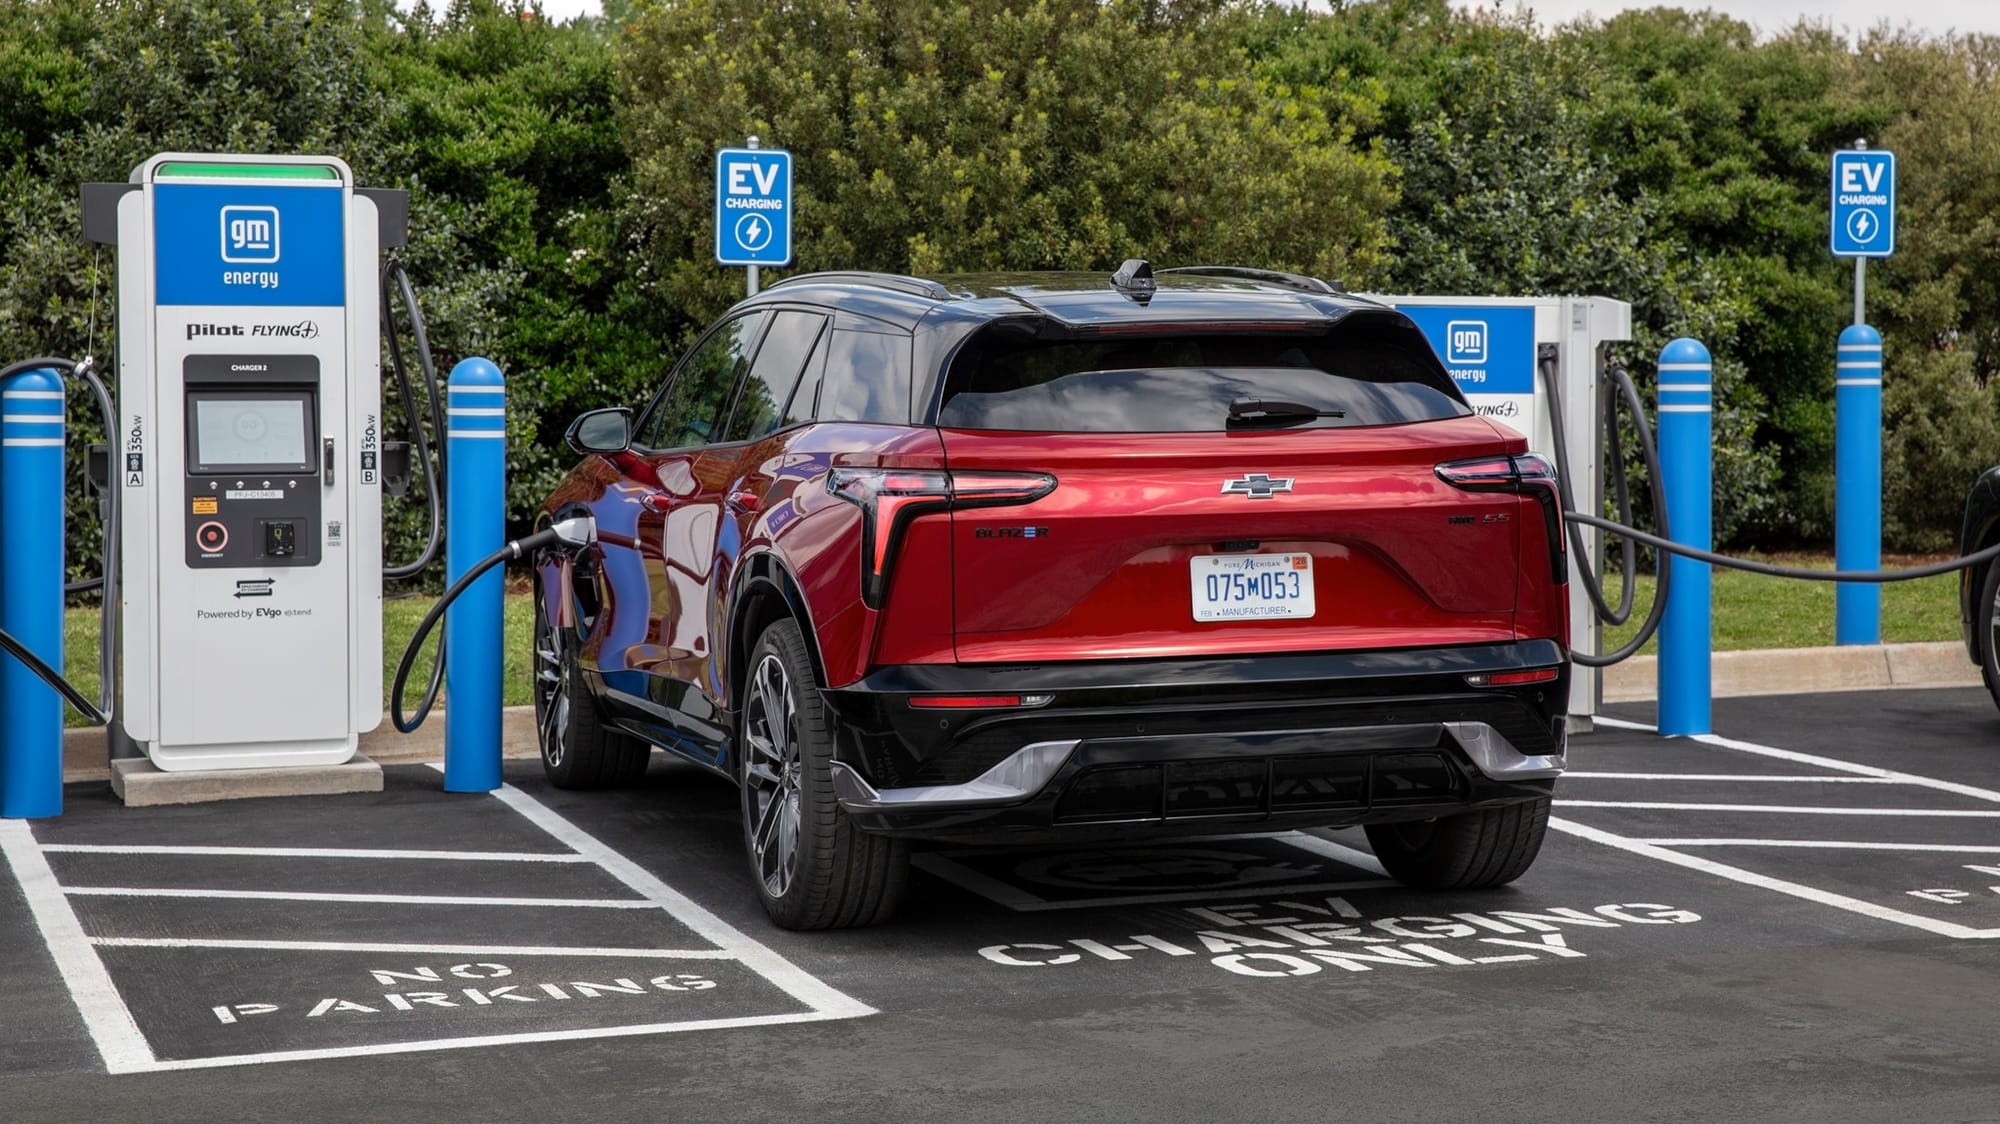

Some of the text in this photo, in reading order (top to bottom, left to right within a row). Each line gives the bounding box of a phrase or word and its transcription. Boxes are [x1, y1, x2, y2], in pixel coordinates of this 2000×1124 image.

[728, 162, 780, 195] EV
[1842, 162, 1885, 192] EV
[725, 197, 782, 210] CHARGING
[1839, 195, 1887, 205] CHARGING
[230, 219, 270, 249] gm
[223, 271, 279, 288] energy
[251, 324, 301, 337] FLYING
[1454, 330, 1481, 354] gm
[130, 473, 140, 484] A
[365, 471, 374, 482] B
[975, 526, 1049, 538] BLAZER
[1239, 558, 1281, 571] MICHIGAN
[1206, 571, 1301, 602] 075M053
[197, 609, 240, 619] Powered
[241, 609, 253, 620] by
[256, 608, 282, 619] EVgo
[1222, 606, 1287, 617] MANUFACTURER
[1184, 897, 1363, 926] EV
[977, 902, 1703, 967] CHARGING
[1210, 932, 1588, 978] ONLY
[369, 962, 513, 985] NO
[212, 974, 717, 1024] PARKING
